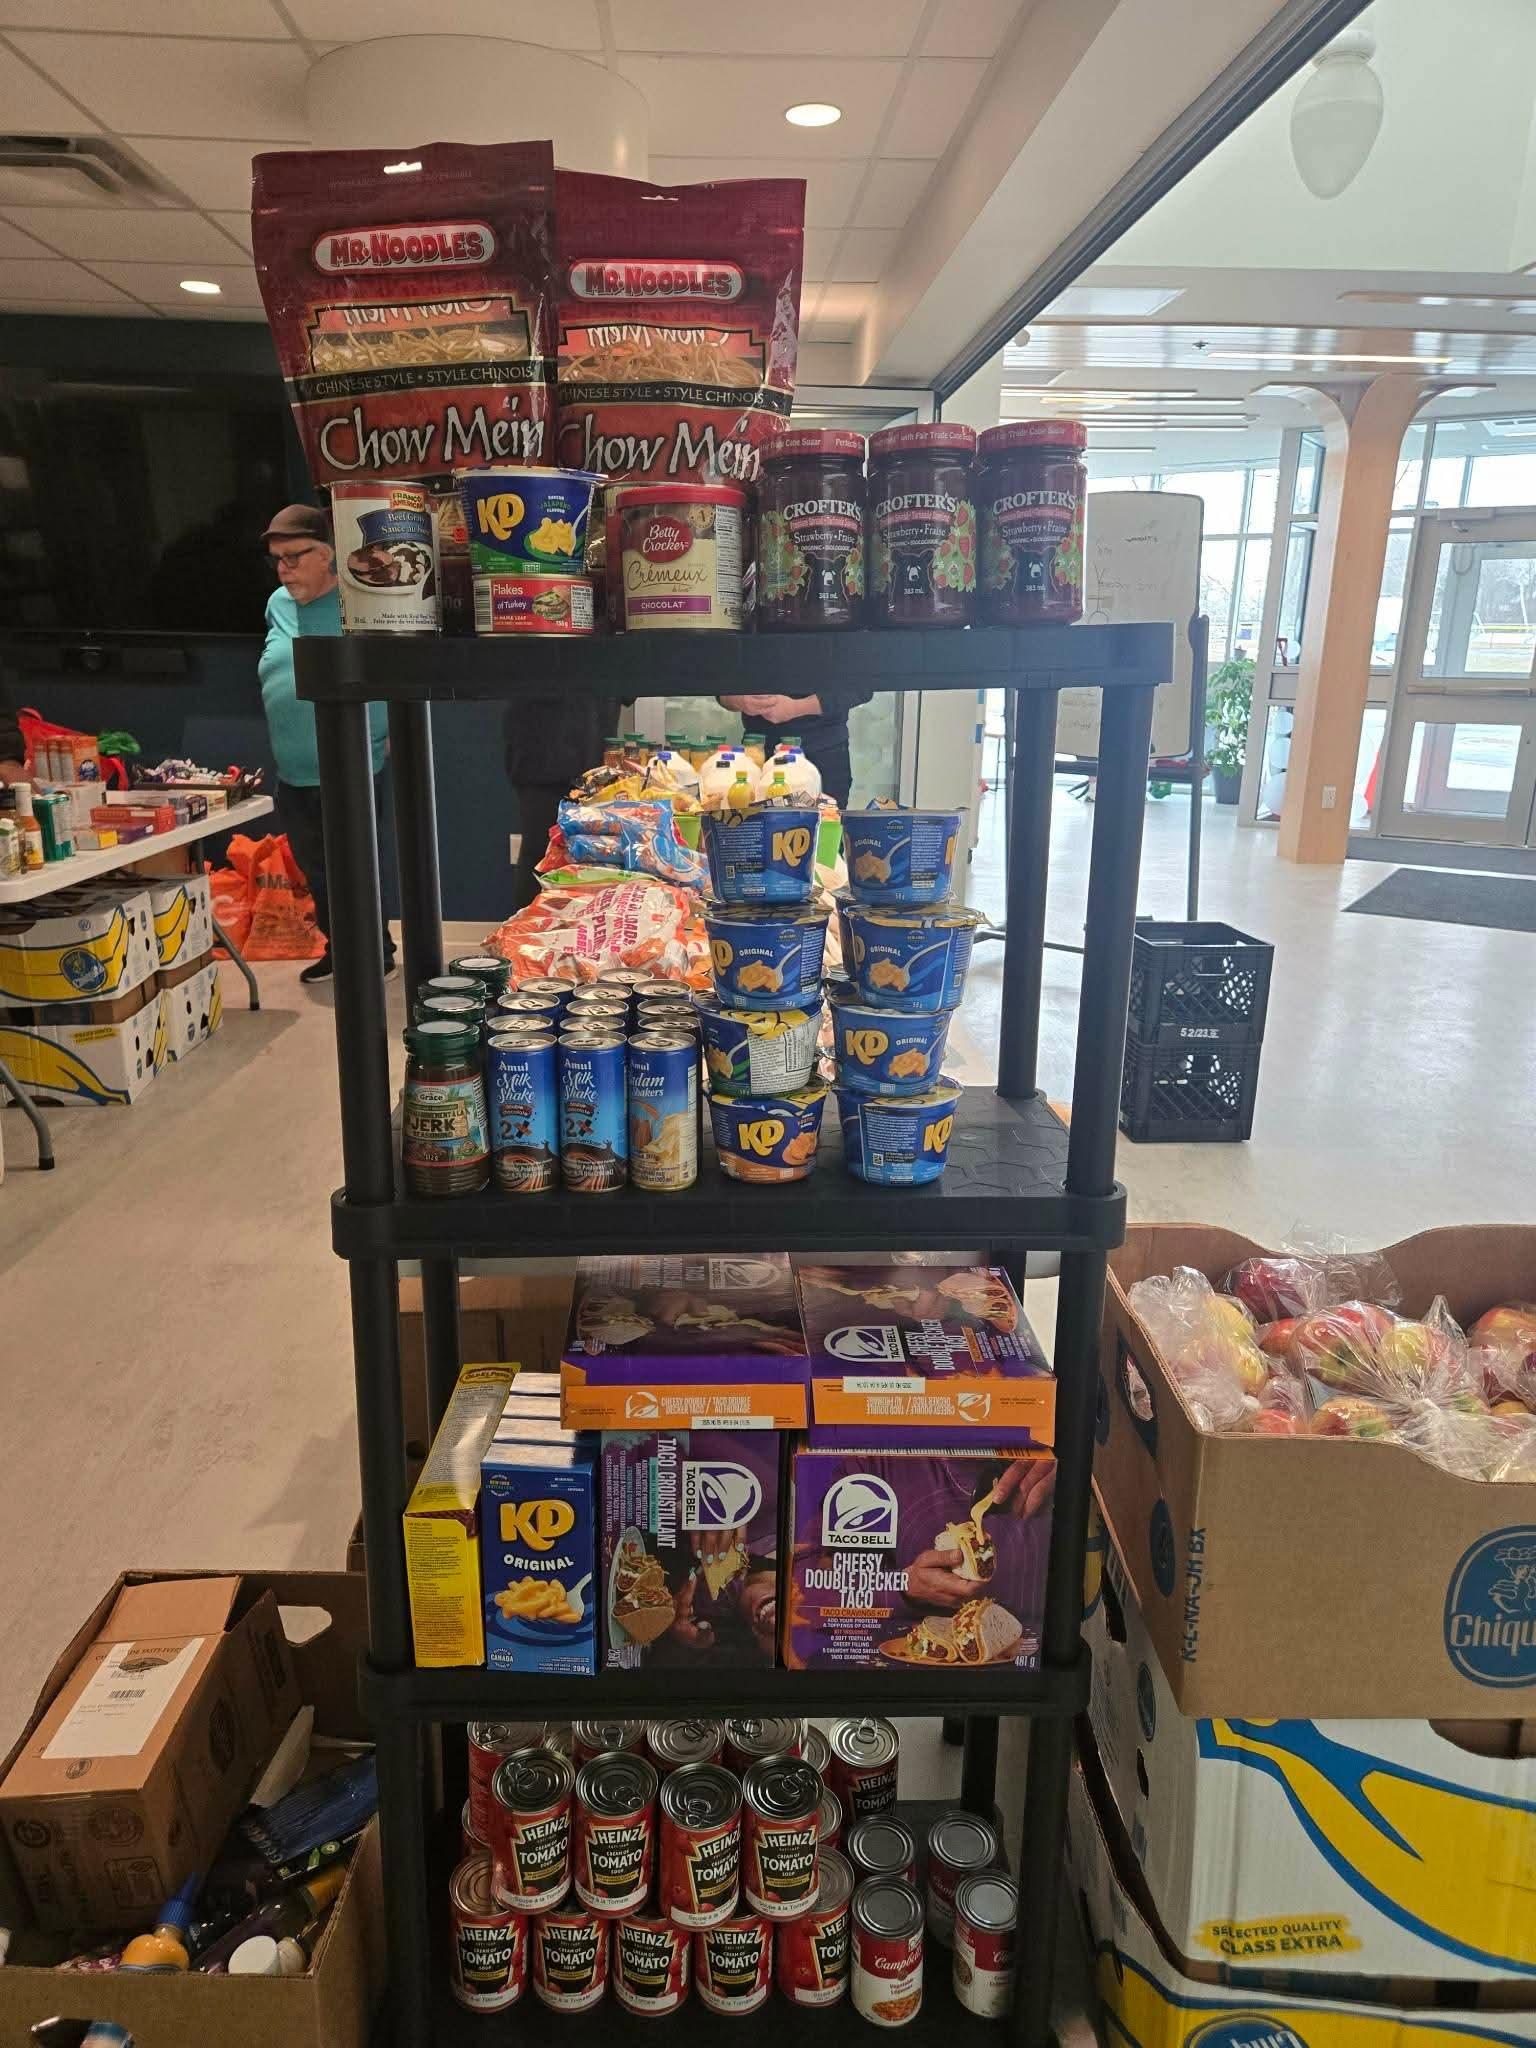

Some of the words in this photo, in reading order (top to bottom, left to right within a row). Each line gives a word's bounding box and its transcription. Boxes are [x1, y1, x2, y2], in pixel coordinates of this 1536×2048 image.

[316, 374, 376, 393] CHINESE
[377, 371, 415, 389] STYLE
[426, 367, 467, 383] STYLE
[469, 364, 534, 382] CHINOIS
[614, 386, 652, 399] STYLE
[664, 385, 703, 401] STYLE
[704, 389, 765, 405] CHINOIS
[321, 406, 436, 471] Chow
[445, 397, 544, 463] Mein
[669, 414, 760, 482] Mein
[784, 500, 861, 522] CROFTER'S
[876, 492, 957, 518] CROFTER'S
[993, 490, 1076, 515] CROFTER'S
[381, 525, 405, 534] Sauce
[650, 525, 680, 541] Betty
[794, 530, 834, 544] Strawberry
[837, 529, 855, 544] Fraise
[883, 525, 919, 539] Strawberry
[924, 523, 946, 537] Fraise
[1002, 522, 1041, 538] Strawberry
[642, 538, 685, 553] Crocker
[627, 561, 708, 591] Crémeux
[493, 584, 524, 595] Flakes
[504, 601, 527, 610] Turkey
[641, 601, 683, 609] CHOCOLAT
[772, 827, 811, 867] KD
[739, 948, 774, 957] ORIGINAL
[870, 945, 901, 957] ORIGINAL
[845, 1029, 889, 1065] KD
[895, 1036, 928, 1046] ORIGINAL
[499, 1061, 529, 1072] Amul
[565, 1058, 592, 1070] Amul
[497, 1073, 533, 1092] Milk
[562, 1070, 595, 1090] Milk
[419, 1092, 443, 1101] Grace
[500, 1088, 535, 1104] Shake
[565, 1085, 597, 1103] Shake
[411, 1118, 456, 1132] JERK
[738, 1119, 785, 1156] KD
[885, 1328, 896, 1342] BELL
[921, 1319, 946, 1343] DECKER
[889, 1343, 900, 1358] TACO
[904, 1331, 930, 1356] CHEESY
[946, 1335, 969, 1352] TACO
[927, 1344, 956, 1370] DOUBLE
[658, 1438, 677, 1467] TACO
[686, 1467, 696, 1496] TACO
[658, 1472, 677, 1548] CROUSTILLANT
[500, 1500, 575, 1552] KD
[828, 1534, 859, 1545] TACO
[503, 1554, 575, 1571] ORIGINAL
[833, 1552, 884, 1573] CHEESY
[805, 1568, 855, 1590] DOUBLE
[859, 1571, 909, 1592] DECKER
[839, 1589, 874, 1609] TACO
[490, 1653, 514, 1662] CANADA
[861, 1769, 897, 1791] HEINZ
[526, 1816, 566, 1842] HEINZ
[600, 1829, 640, 1844] HEINZ
[702, 1831, 738, 1857] HEINZ
[770, 1832, 811, 1847] HEINZ
[520, 1837, 568, 1865] TOMATO
[591, 1848, 642, 1869] TOMATO
[696, 1851, 738, 1882] TOMATO
[711, 1856, 726, 1867] CREAM
[761, 1854, 813, 1872] TOMATO
[466, 1929, 505, 1941] HEINZ
[552, 1929, 590, 1941] HEINZ
[626, 1929, 665, 1946] HEINZ
[1212, 1925, 1278, 1938] SELECTED
[1282, 1920, 1342, 1934] QUALITY
[716, 1932, 756, 1945] HEINZ
[1219, 1939, 1277, 1955] CLASS
[1280, 1935, 1343, 1950] EXTRA
[462, 1948, 511, 1965] TOMATO
[545, 1947, 595, 1965] TOMATO
[622, 1947, 669, 1969] TOMATO
[633, 1949, 647, 1957] CREAM
[709, 1950, 759, 1969] TOMATO
